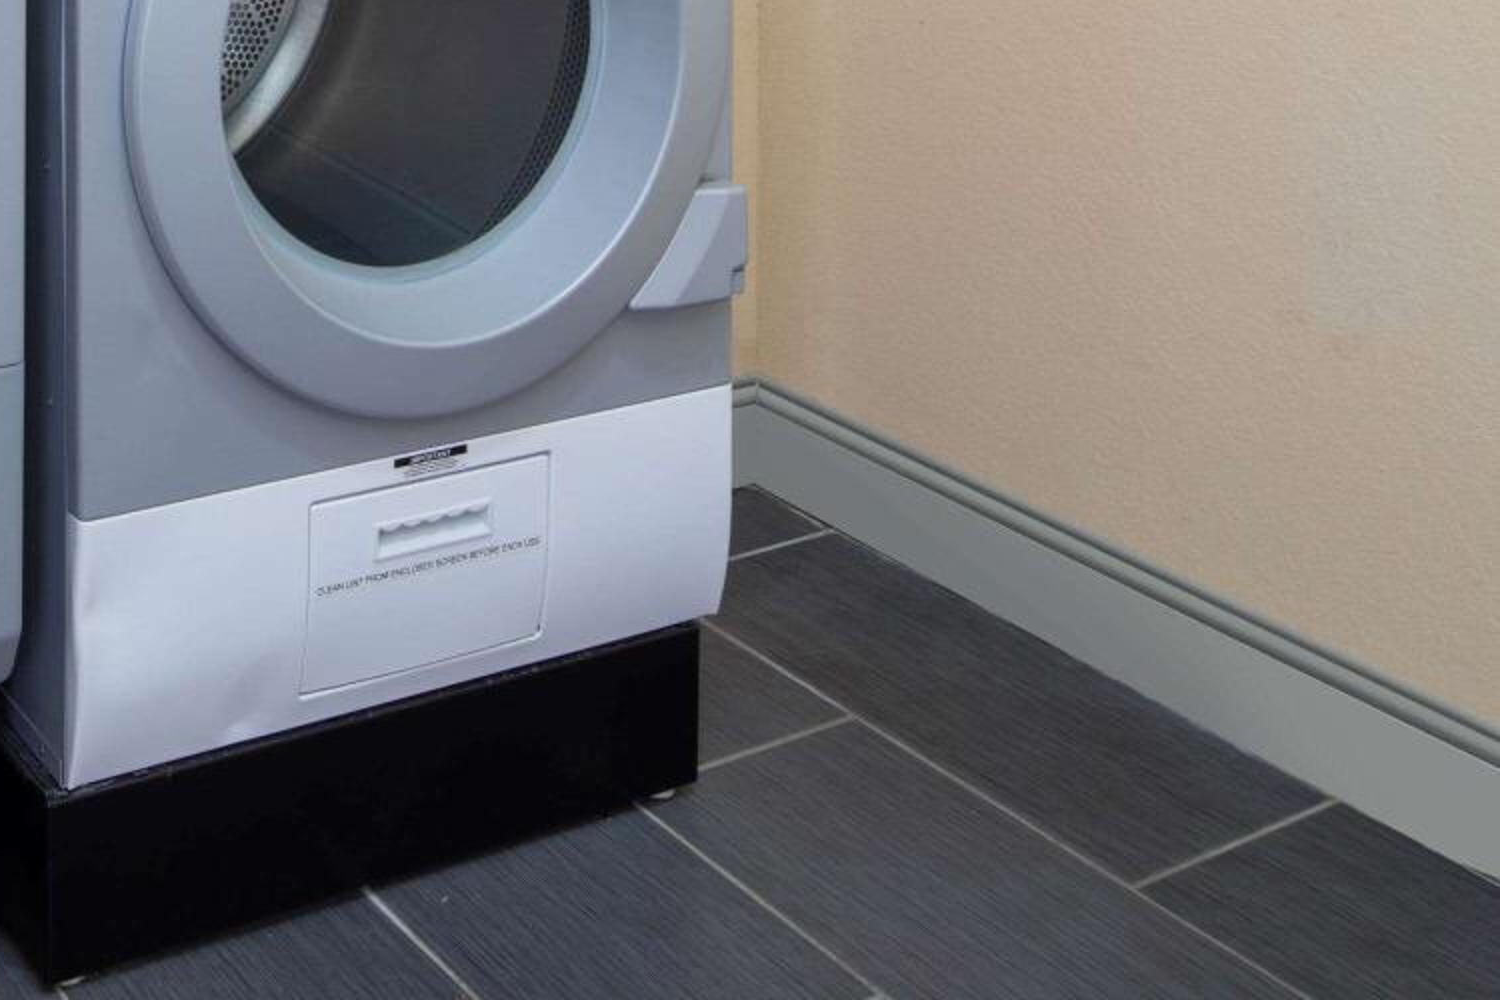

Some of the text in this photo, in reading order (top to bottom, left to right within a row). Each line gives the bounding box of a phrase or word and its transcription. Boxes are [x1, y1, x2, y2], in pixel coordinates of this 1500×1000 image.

[315, 582, 344, 597] CLEAN
[365, 571, 389, 585] FROM
[501, 541, 522, 554] EACH
[524, 536, 542, 549] USE
